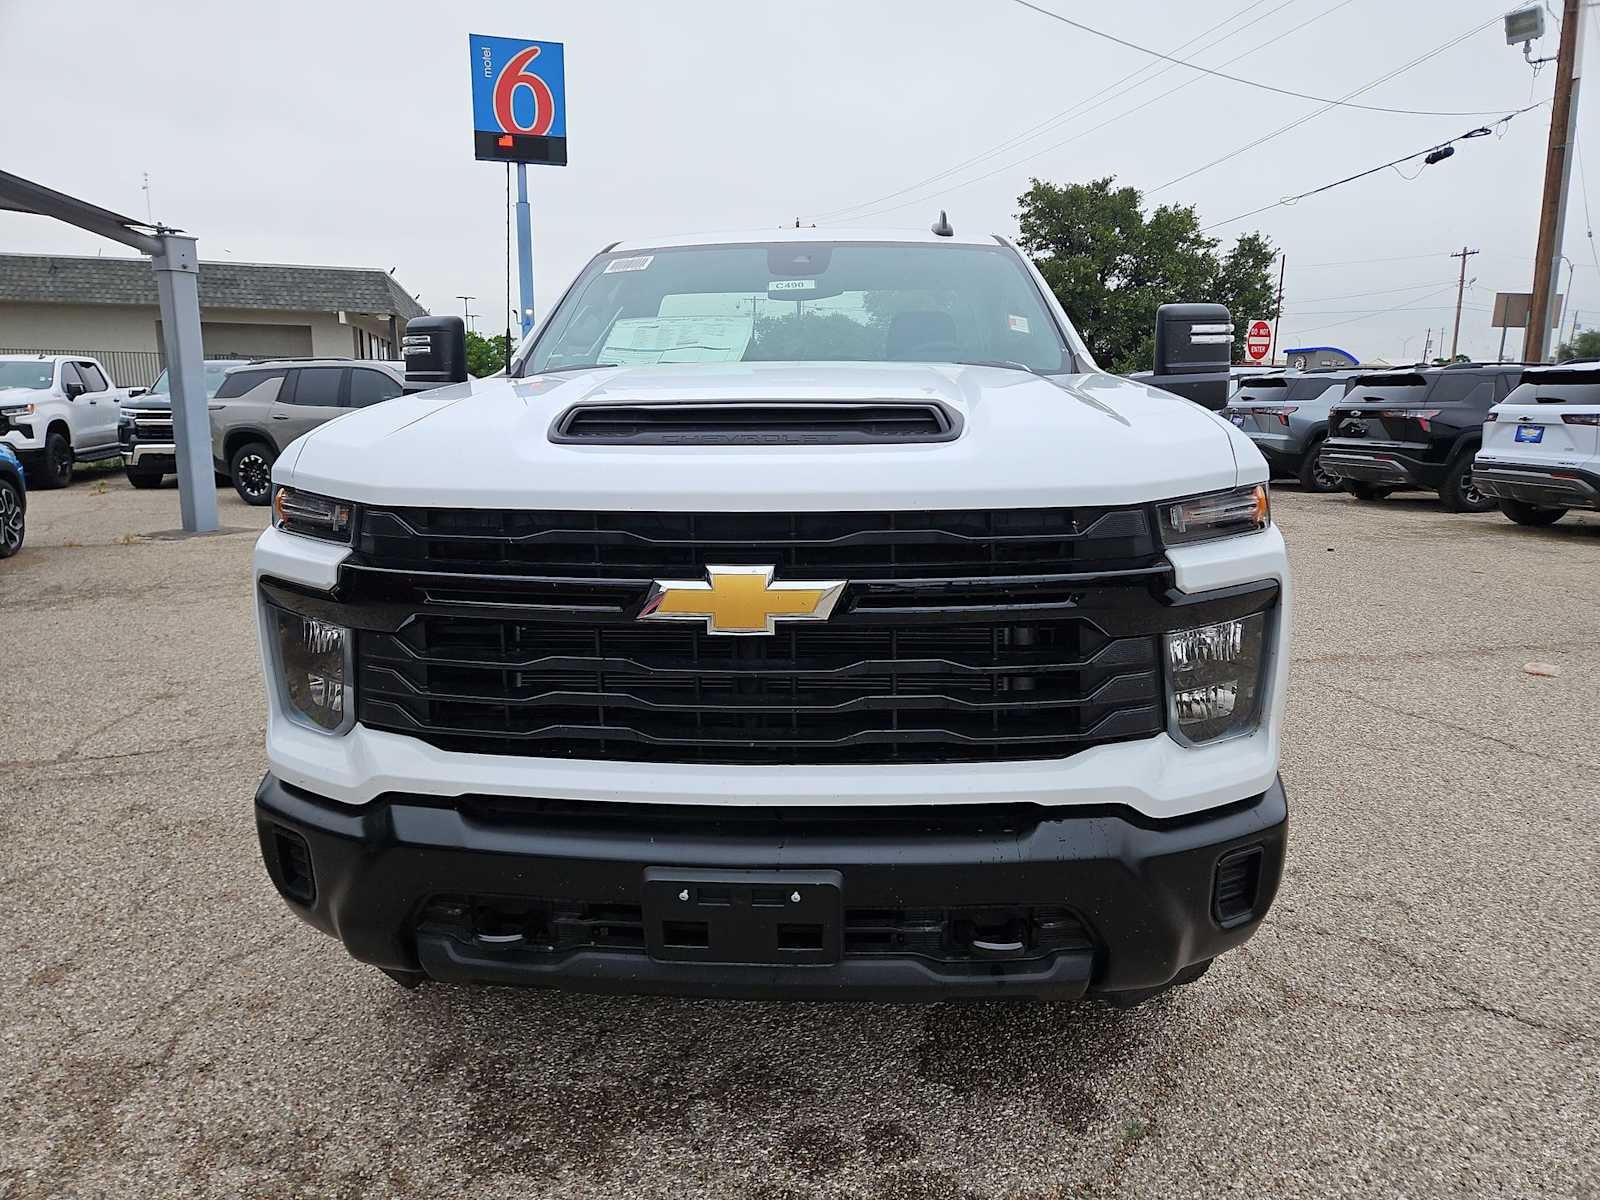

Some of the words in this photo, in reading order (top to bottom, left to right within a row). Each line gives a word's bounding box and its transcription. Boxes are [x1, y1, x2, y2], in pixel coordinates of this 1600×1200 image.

[481, 47, 492, 78] motel
[493, 46, 554, 136] 6
[1251, 328, 1259, 336] DO
[1259, 328, 1269, 336] NOT
[662, 434, 839, 444] CHEVROLET
